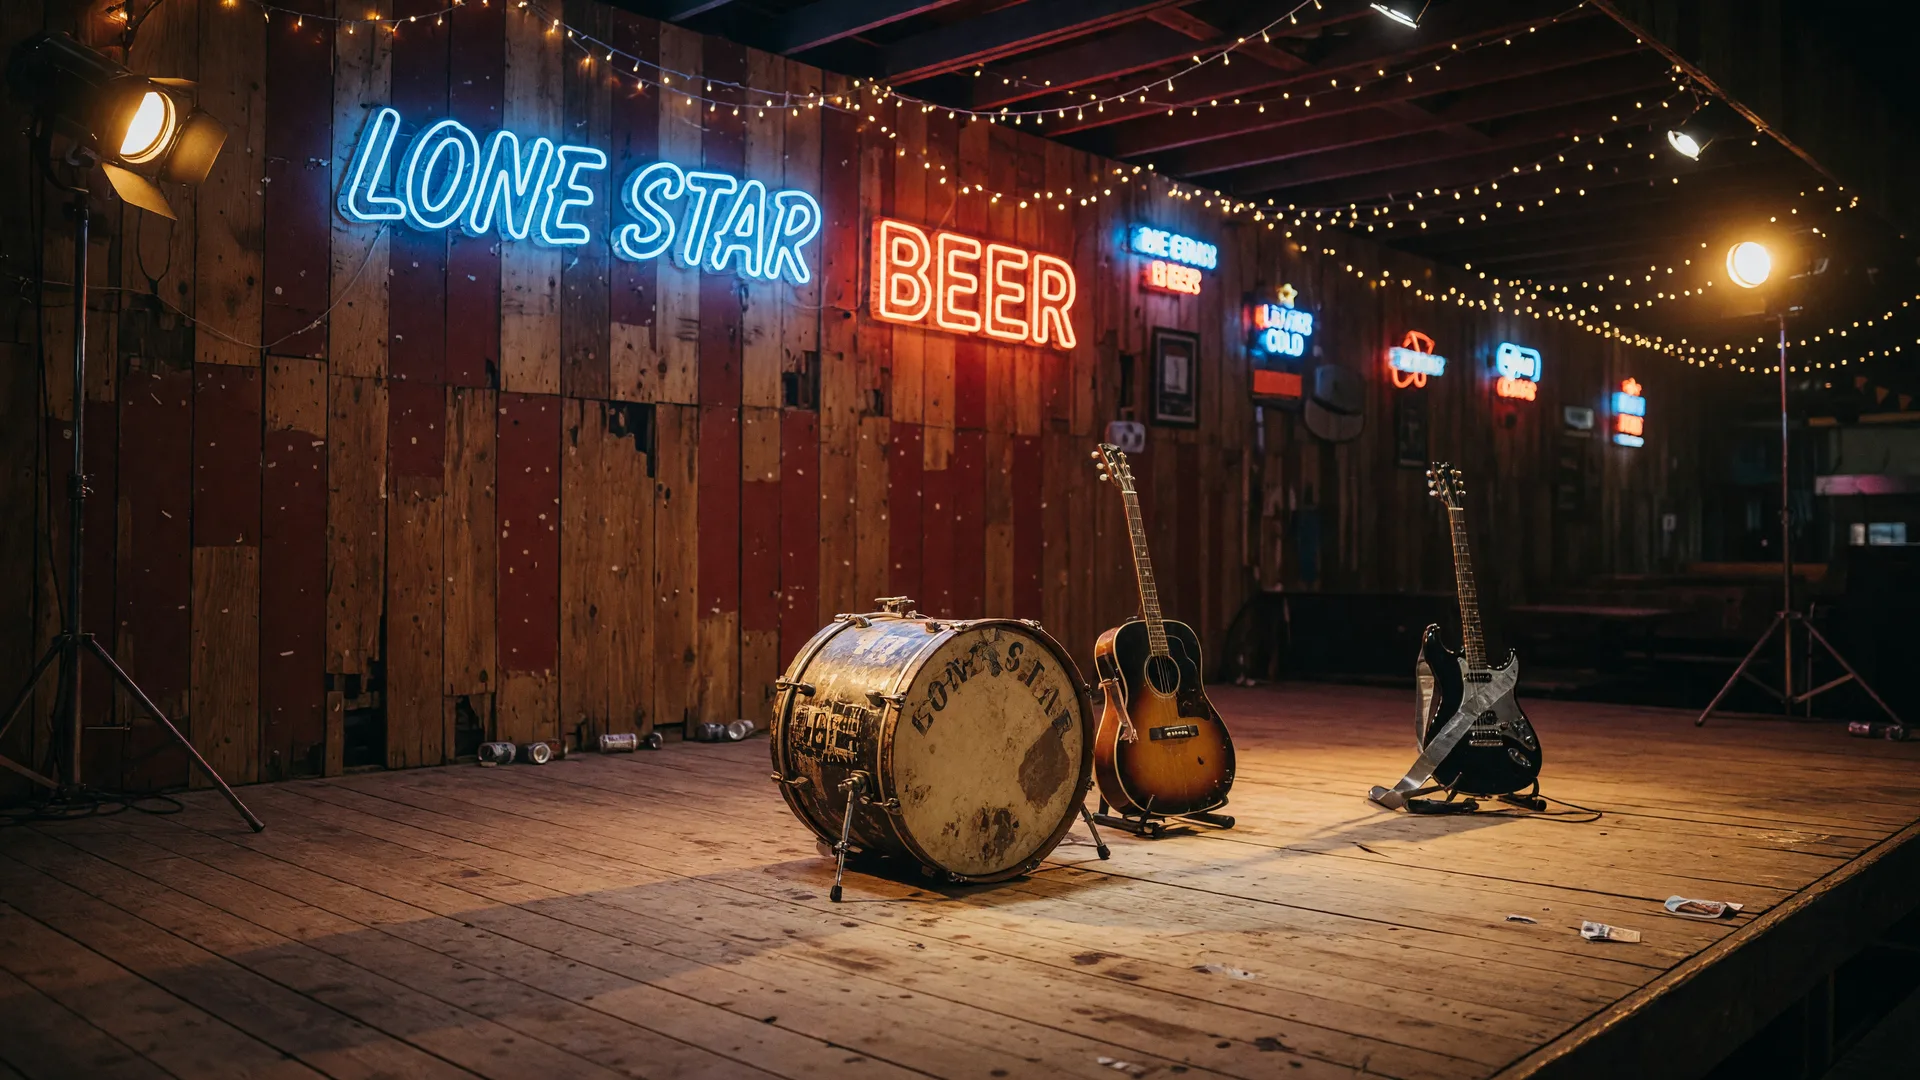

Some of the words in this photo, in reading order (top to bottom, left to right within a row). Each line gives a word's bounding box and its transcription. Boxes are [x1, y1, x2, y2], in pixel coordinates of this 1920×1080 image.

[344, 107, 607, 247] LONE
[616, 161, 823, 285] STAR
[876, 218, 1078, 351] BEER
[1265, 328, 1304, 357] COLD
